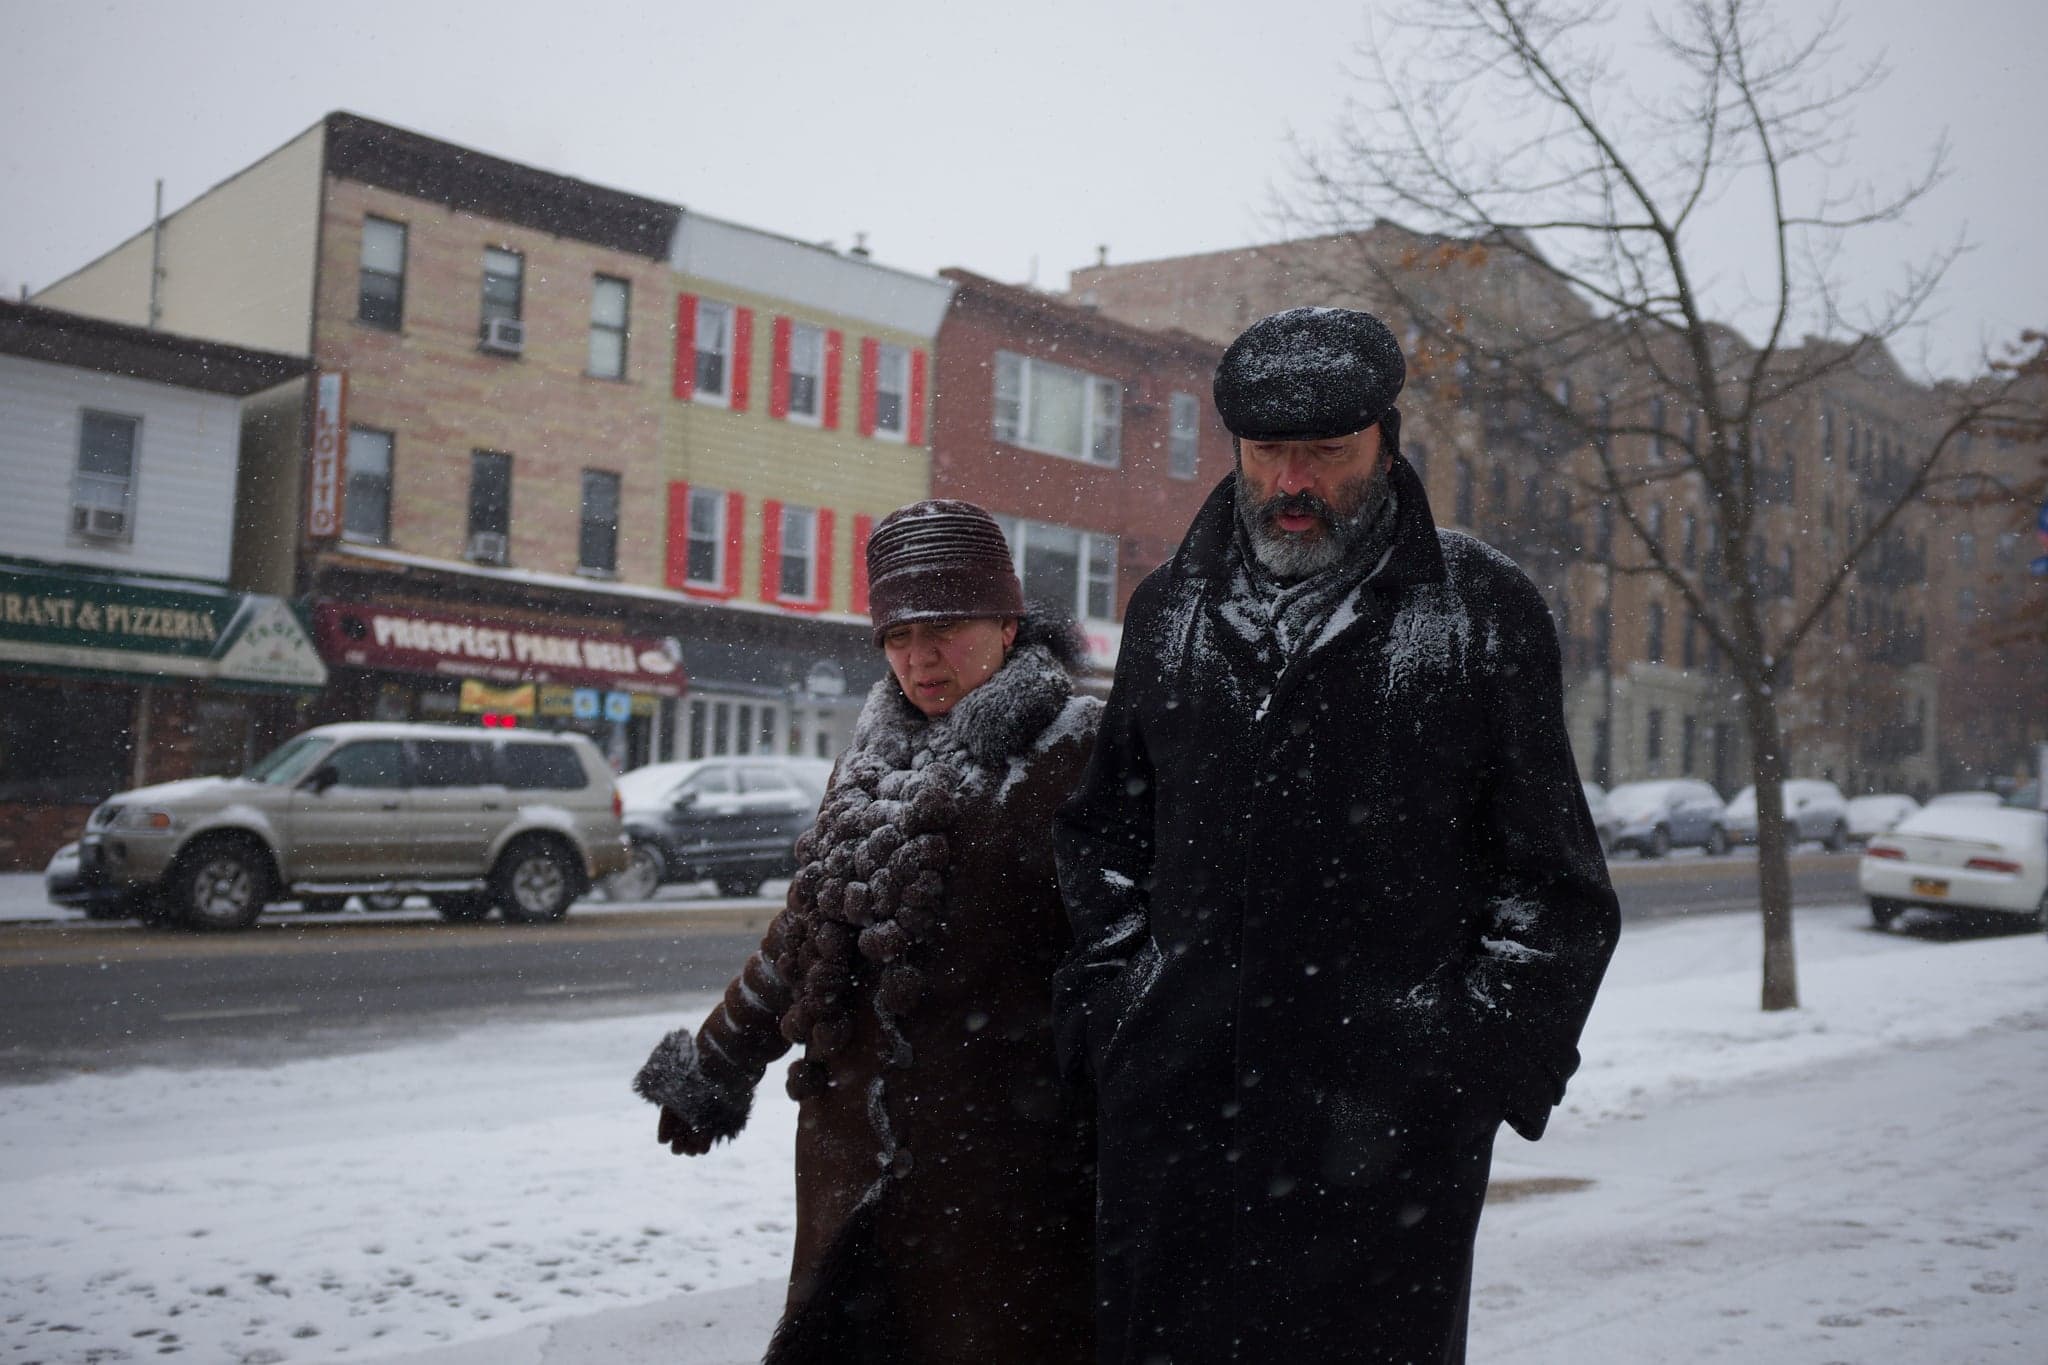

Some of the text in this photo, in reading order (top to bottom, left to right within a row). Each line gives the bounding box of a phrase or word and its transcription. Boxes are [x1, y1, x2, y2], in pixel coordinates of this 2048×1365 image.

[316, 408, 333, 529] LOTTO
[0, 593, 73, 627] RANT
[76, 599, 98, 630] &
[105, 603, 217, 641] PIZZERIA
[372, 615, 511, 660] PROSPECT
[513, 632, 582, 668] PARK
